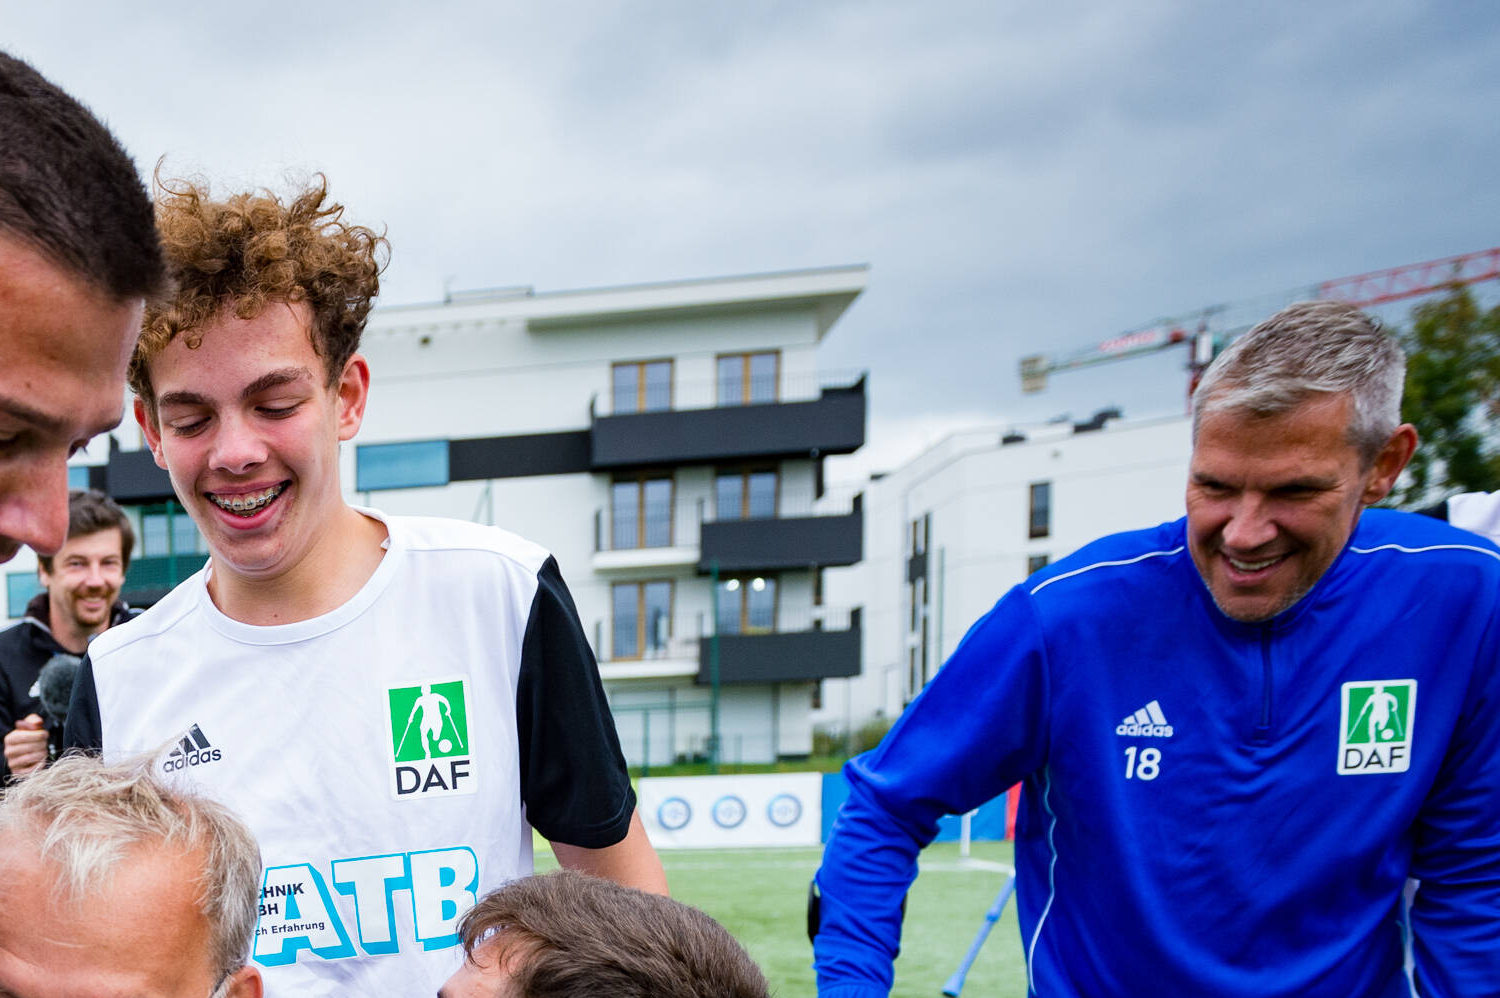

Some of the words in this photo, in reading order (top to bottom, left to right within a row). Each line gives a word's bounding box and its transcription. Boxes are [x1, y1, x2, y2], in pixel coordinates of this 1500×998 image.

[1116, 723, 1174, 737] adidas
[162, 749, 222, 773] adidas
[1124, 746, 1162, 781] 18
[1344, 745, 1406, 770] DAF
[395, 759, 470, 796] DAF
[252, 845, 480, 967] ATB
[272, 921, 325, 935] Erfahrung
